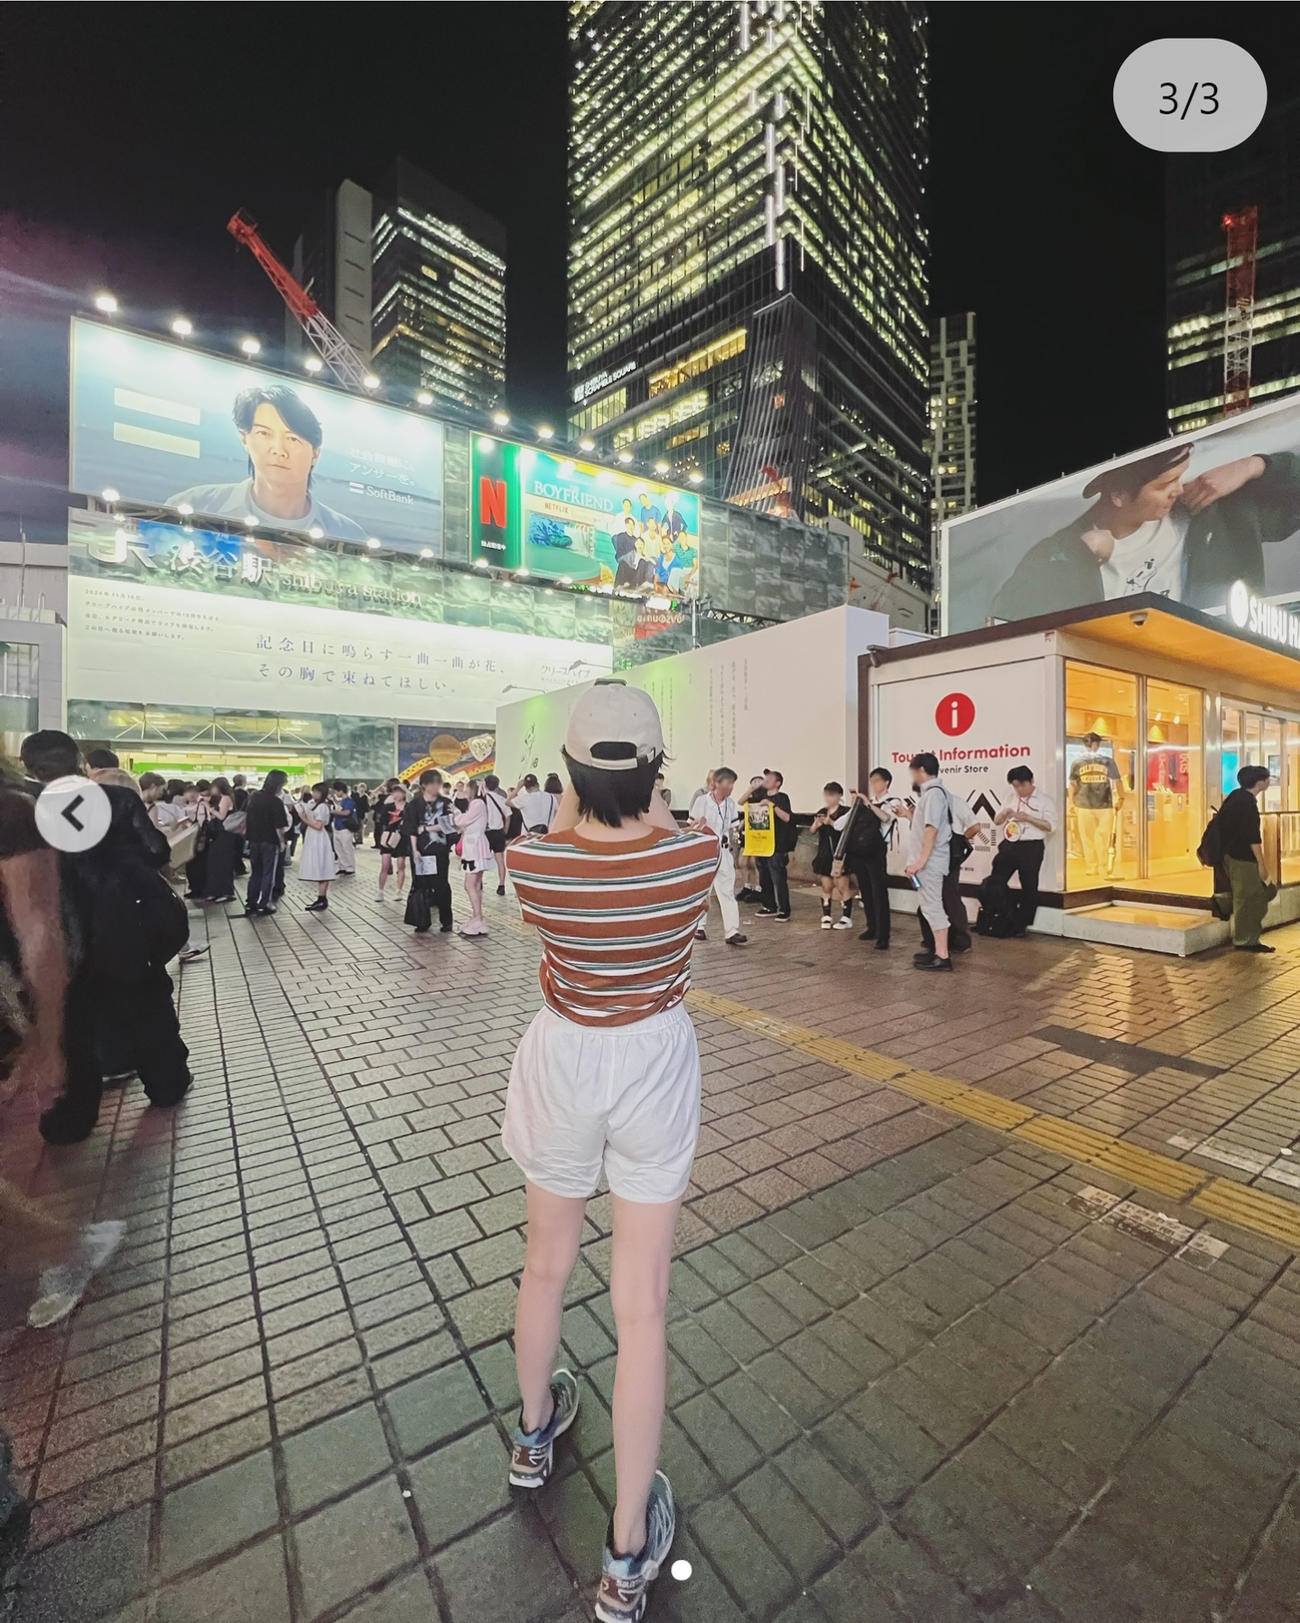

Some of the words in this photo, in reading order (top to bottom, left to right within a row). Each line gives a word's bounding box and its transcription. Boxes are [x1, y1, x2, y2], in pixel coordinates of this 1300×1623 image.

[366, 485, 415, 505] SoftBank
[479, 475, 507, 529] N
[534, 480, 614, 513] BOYFRIEND
[167, 540, 273, 587] 渋谷駅
[362, 582, 423, 607] station
[1249, 597, 1288, 644] SHIBU
[258, 661, 457, 693] その胸で束ねてほしい。
[939, 744, 1031, 761] Information
[964, 764, 990, 774] Store
